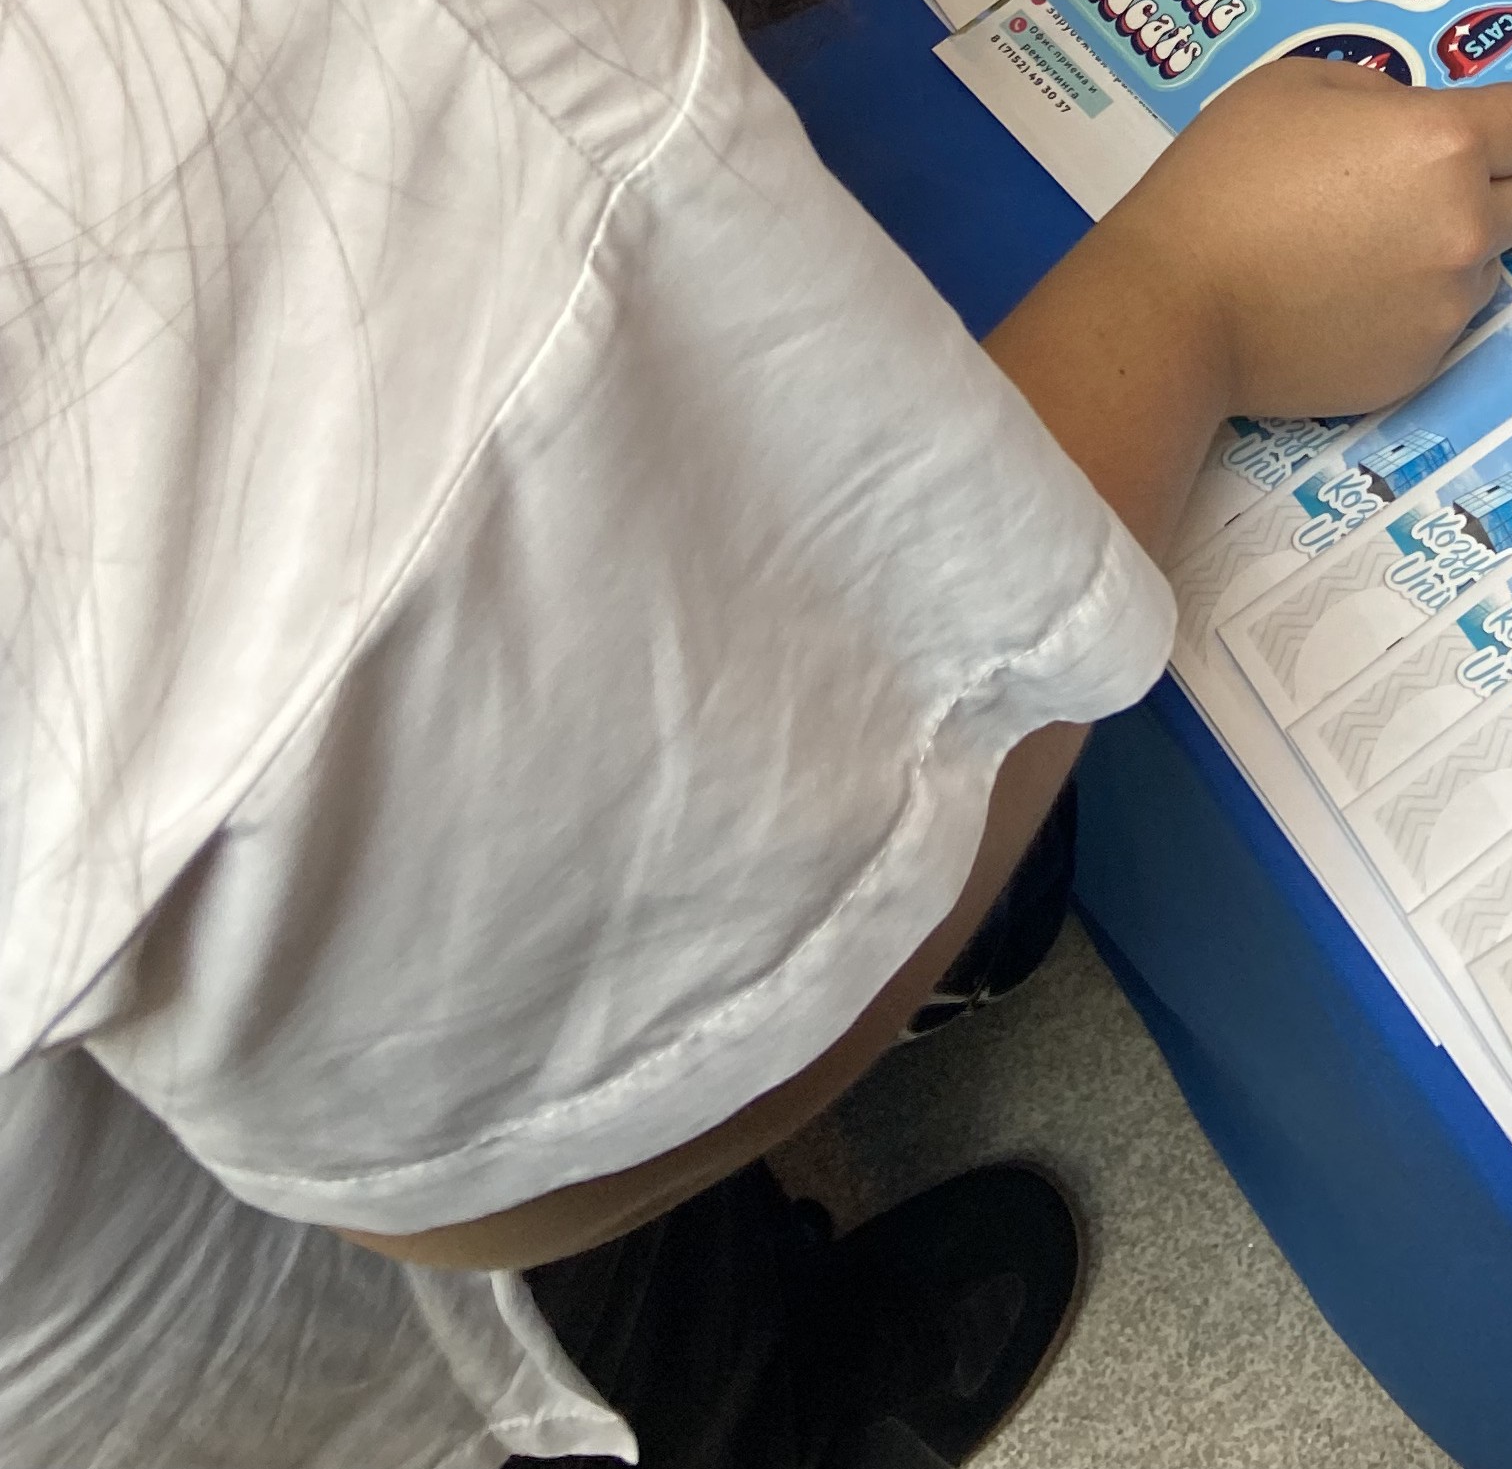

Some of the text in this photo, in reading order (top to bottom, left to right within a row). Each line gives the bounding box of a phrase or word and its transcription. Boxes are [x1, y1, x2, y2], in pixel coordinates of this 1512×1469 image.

[991, 34, 1071, 114] 8 (7152) 49 30 37
[1021, 42, 1079, 99] рекрутинга
[1029, 26, 1089, 87] Офис приема
